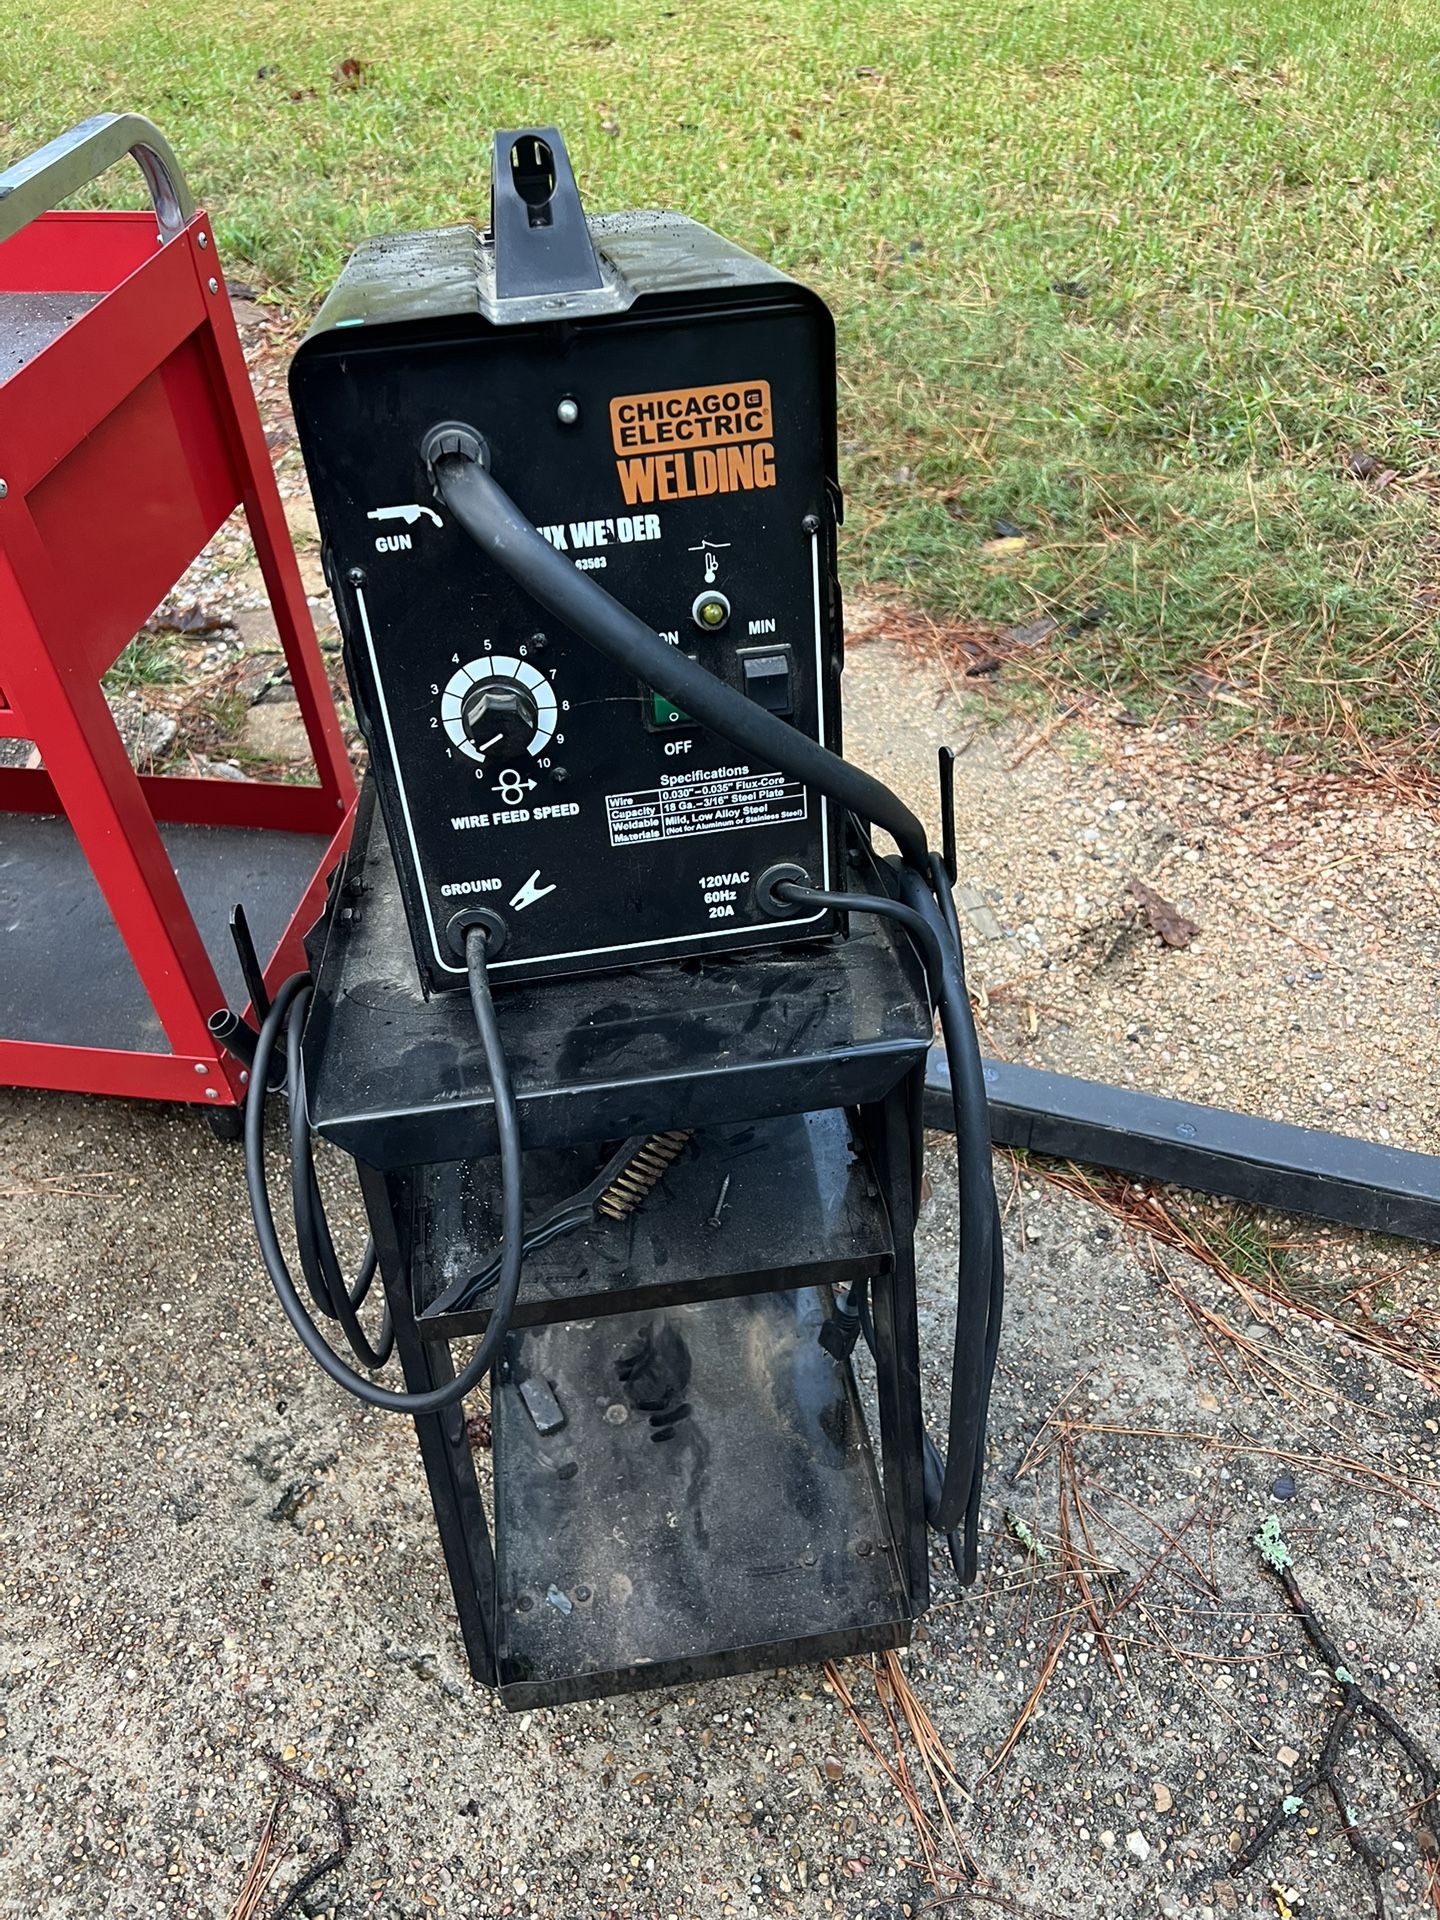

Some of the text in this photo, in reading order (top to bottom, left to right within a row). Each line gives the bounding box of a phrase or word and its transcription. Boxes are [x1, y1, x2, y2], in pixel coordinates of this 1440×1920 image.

[618, 392, 741, 424] CHICAGO
[619, 411, 763, 447] ELECTRIC
[616, 442, 776, 505] WELDING
[375, 534, 413, 552] GUN
[748, 618, 776, 635] MIN
[483, 639, 492, 651] 5
[519, 645, 527, 656] 6
[451, 653, 460, 664] 4
[549, 669, 557, 680] 7
[430, 684, 439, 695] 3
[562, 700, 570, 711] 8
[430, 717, 438, 728] 2
[556, 733, 564, 744] 9
[445, 747, 452, 758] 1
[664, 740, 692, 756] OFF
[536, 757, 551, 769] 10
[475, 768, 483, 779] 0
[660, 765, 749, 786] Specifications
[609, 797, 634, 807] Wire
[735, 777, 785, 790] Flux-Core
[611, 807, 656, 820] Capacity
[664, 802, 676, 812] 18
[731, 791, 757, 803] Steel
[758, 789, 784, 799] Plate
[450, 802, 580, 830] WIRE FEED SPEED
[612, 803, 768, 832] Weldable Mild, Low Alloy Steel
[614, 808, 803, 843] Materials (Not for Aluminum or Stainless Steel)
[440, 878, 502, 897] GROUND
[698, 871, 750, 889] 120VAC
[704, 890, 737, 904] 60Hz
[708, 904, 735, 919] 20A
